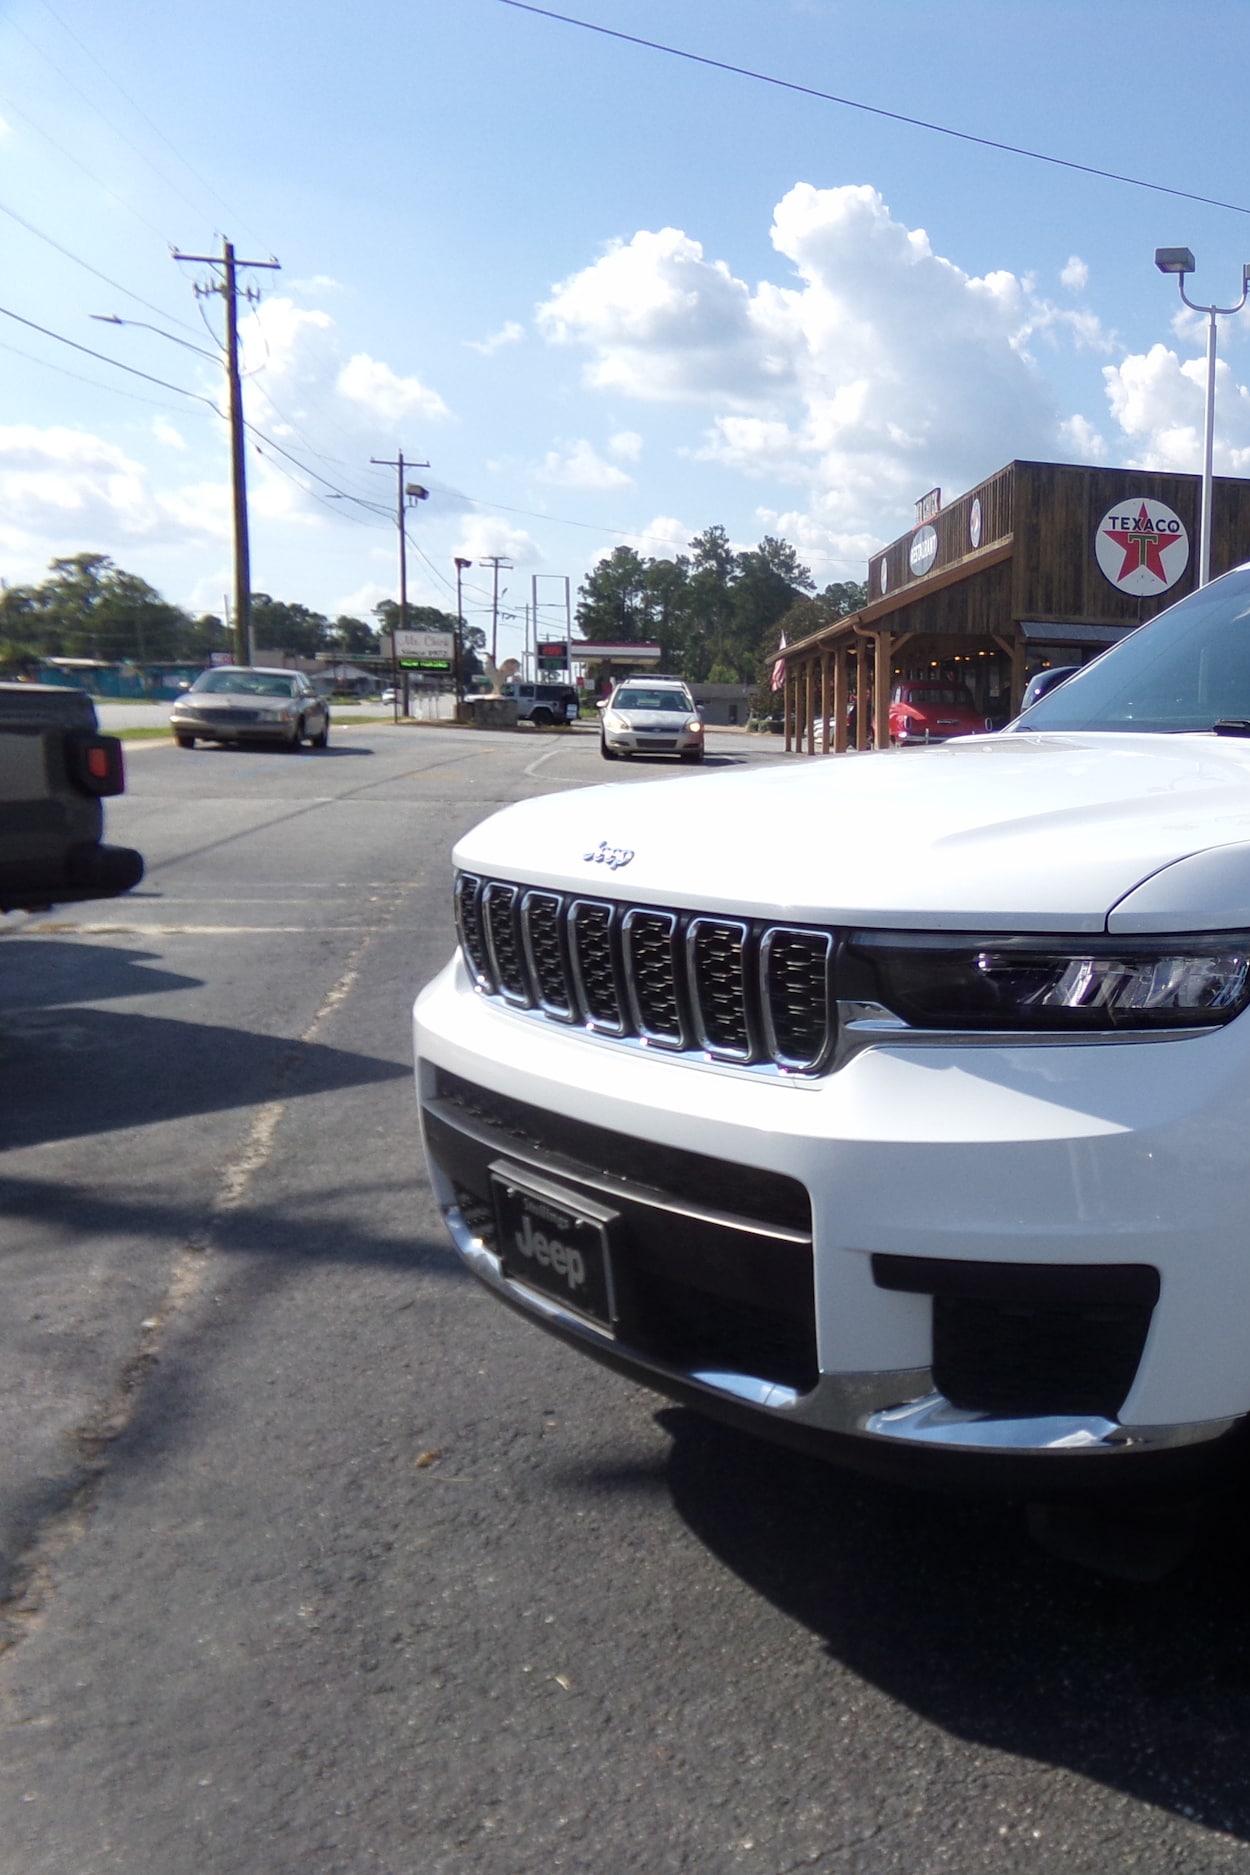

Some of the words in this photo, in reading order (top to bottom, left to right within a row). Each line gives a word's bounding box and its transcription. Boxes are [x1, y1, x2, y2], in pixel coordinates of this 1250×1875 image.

[1108, 516, 1180, 533] TEXACO
[583, 841, 635, 871] Jeep
[514, 1214, 585, 1289] Jeep
